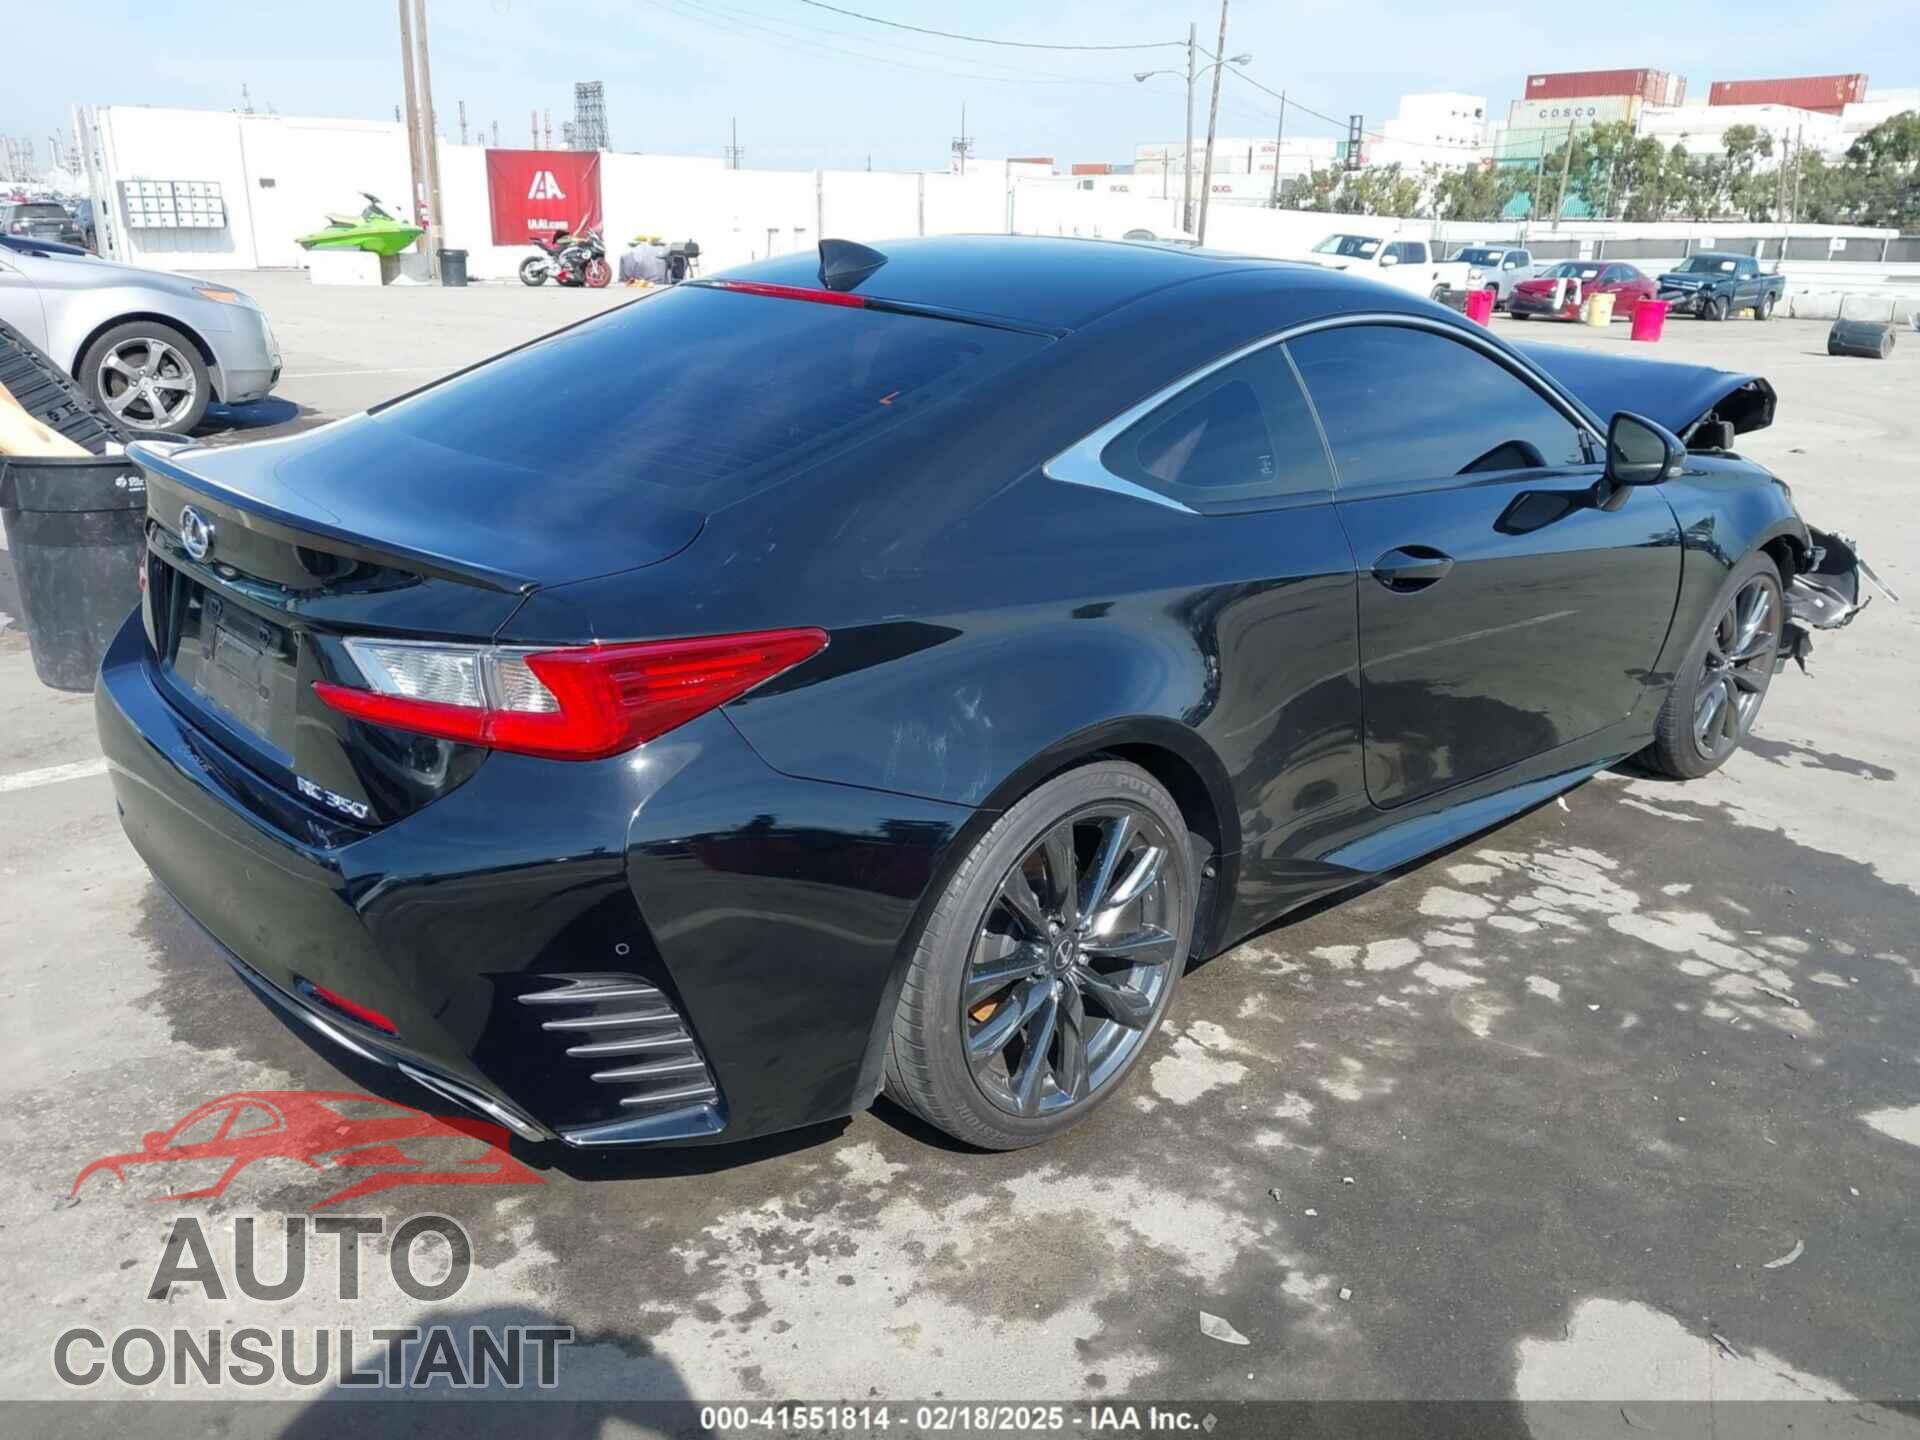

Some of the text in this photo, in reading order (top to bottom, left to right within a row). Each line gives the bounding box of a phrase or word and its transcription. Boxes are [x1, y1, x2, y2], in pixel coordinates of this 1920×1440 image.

[1539, 107, 1596, 119] COSCO
[296, 775, 368, 818] RC 350
